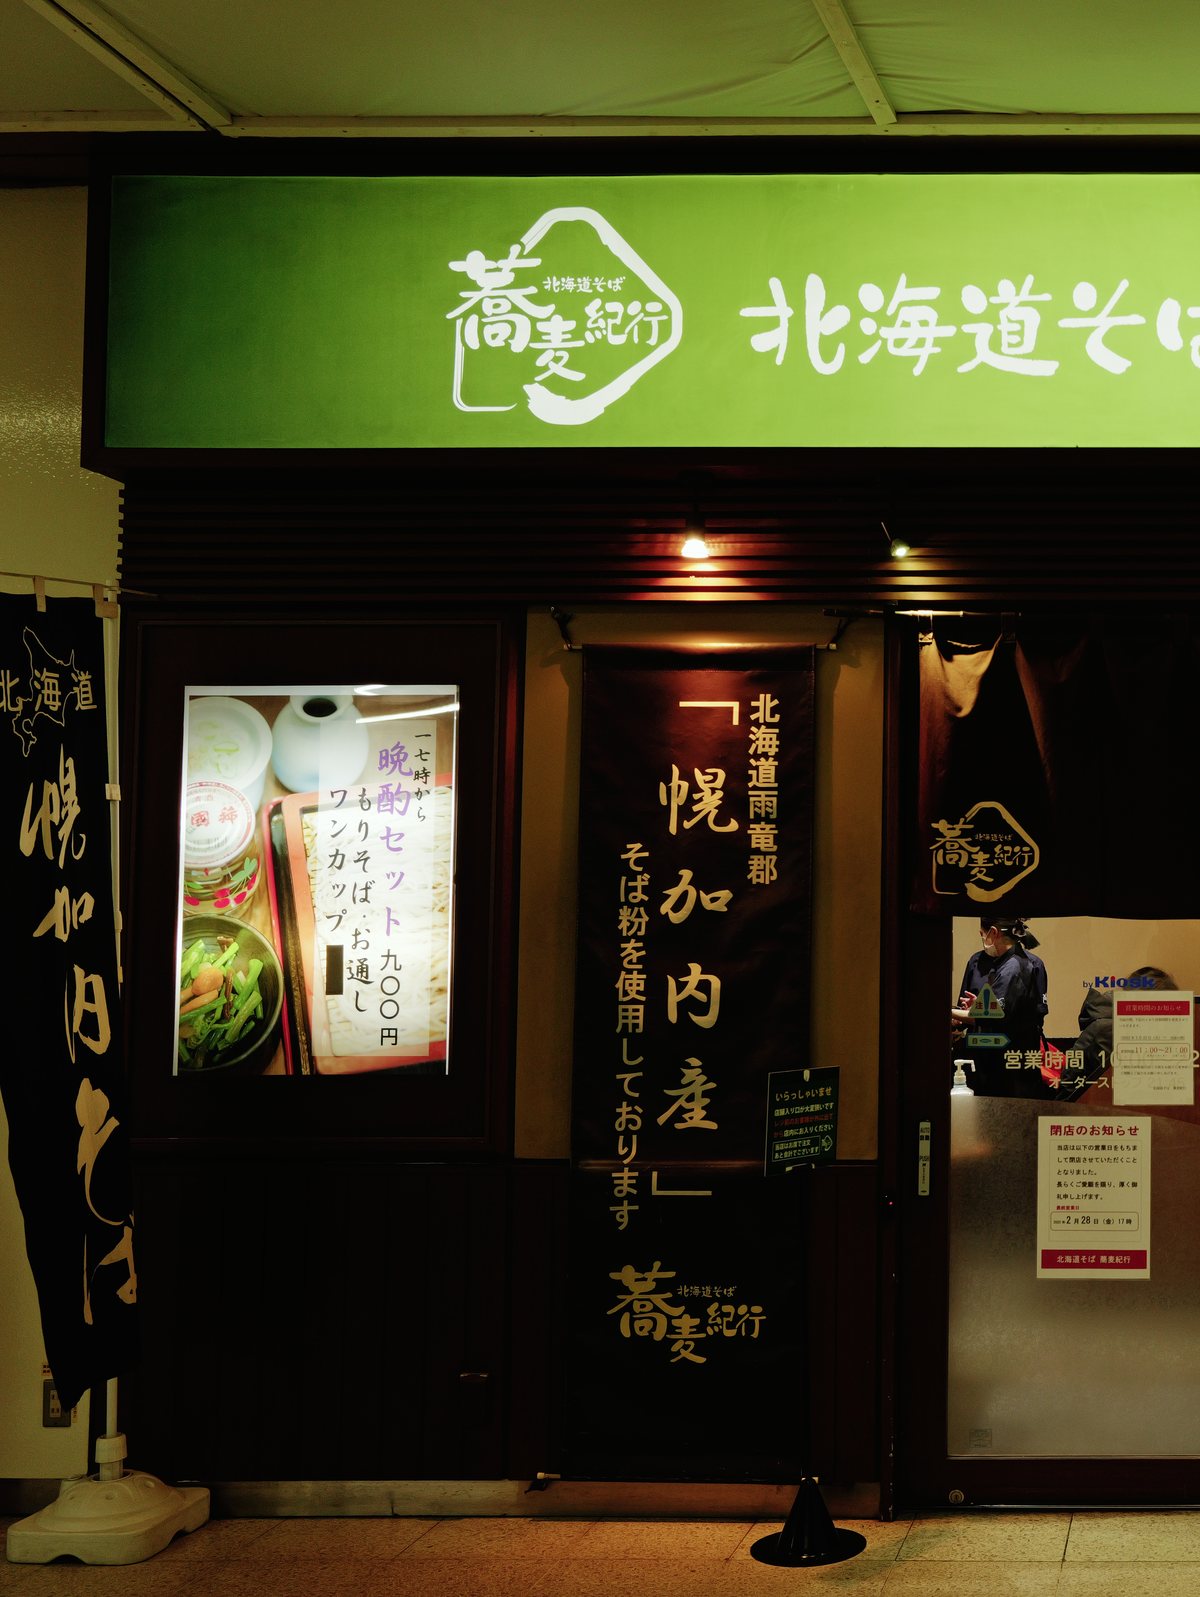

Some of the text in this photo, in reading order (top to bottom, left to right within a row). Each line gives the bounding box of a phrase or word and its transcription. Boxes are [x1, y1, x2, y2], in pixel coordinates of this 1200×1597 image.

[543, 275, 626, 293] 北海道そば
[446, 247, 670, 382] 蕎麦紀行
[0, 666, 97, 713] 北海道
[413, 733, 432, 822] 一七時から
[746, 694, 780, 885] 北海道雨竜郡
[929, 817, 1033, 882] 蕎麦紀行
[975, 833, 1013, 841] 北海道そば
[326, 788, 348, 932] ワンカップ
[347, 788, 375, 1013] もりそば・お通し
[377, 741, 413, 1046] 晩酌セット 九〇〇円
[1082, 976, 1156, 989] by Kiosk
[1125, 1004, 1182, 1012] 営業時間のお知らせ
[609, 842, 650, 1231] そば粉を使用しております
[1003, 1050, 1085, 1070] 営業時間
[775, 1087, 832, 1101] いらっしゃいませ
[1050, 1125, 1139, 1137] 閉店のお知らせ
[1056, 1193, 1104, 1201] 礼申し上げます。
[1056, 1255, 1131, 1264] 北海道そば 蕎麦紀行
[677, 1285, 737, 1299] 北海道そば
[607, 1261, 767, 1364] 蕎麦紀行
